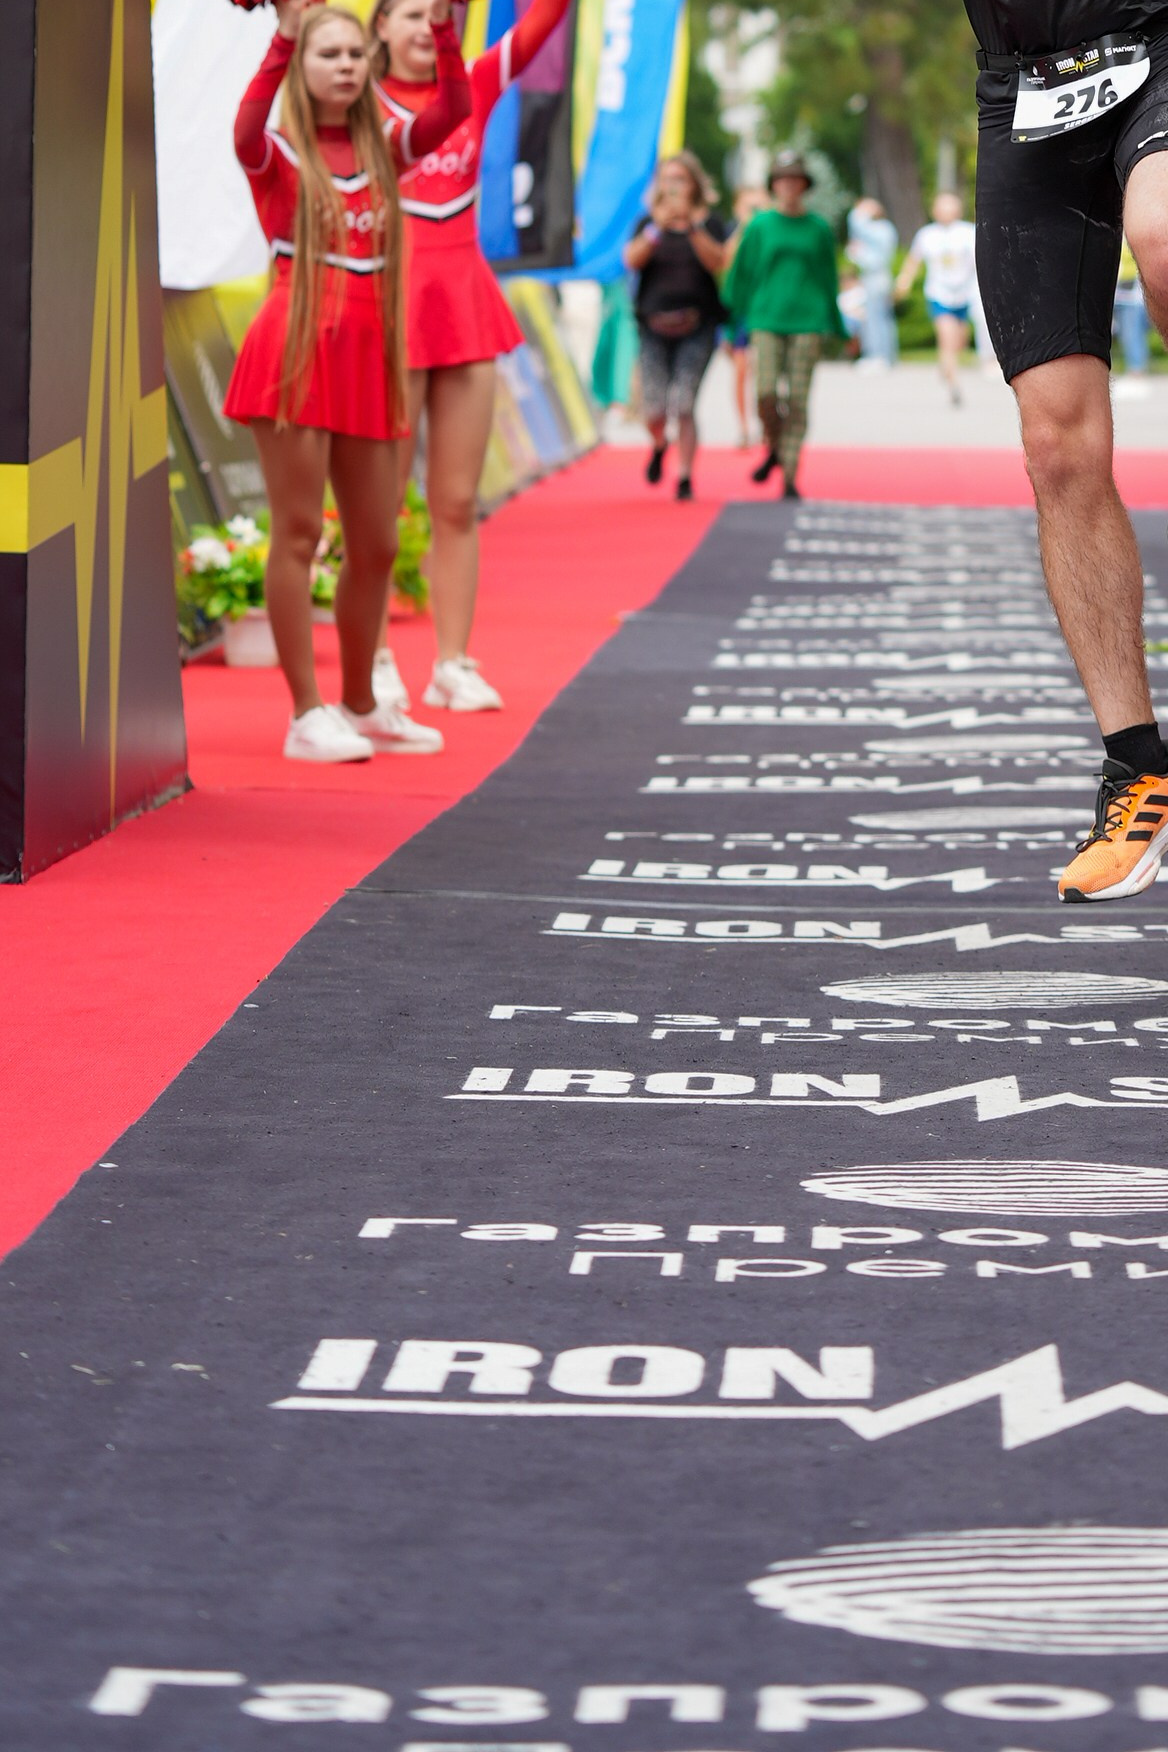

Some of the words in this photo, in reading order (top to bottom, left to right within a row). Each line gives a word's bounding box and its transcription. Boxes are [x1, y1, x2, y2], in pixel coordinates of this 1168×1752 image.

[1055, 57, 1076, 73] IRON
[1053, 77, 1119, 120] 276
[400, 140, 476, 185] ool
[588, 859, 888, 880] IRON
[552, 912, 882, 938] IRON
[461, 1067, 882, 1098] IRON
[297, 1338, 874, 1400] IRON
